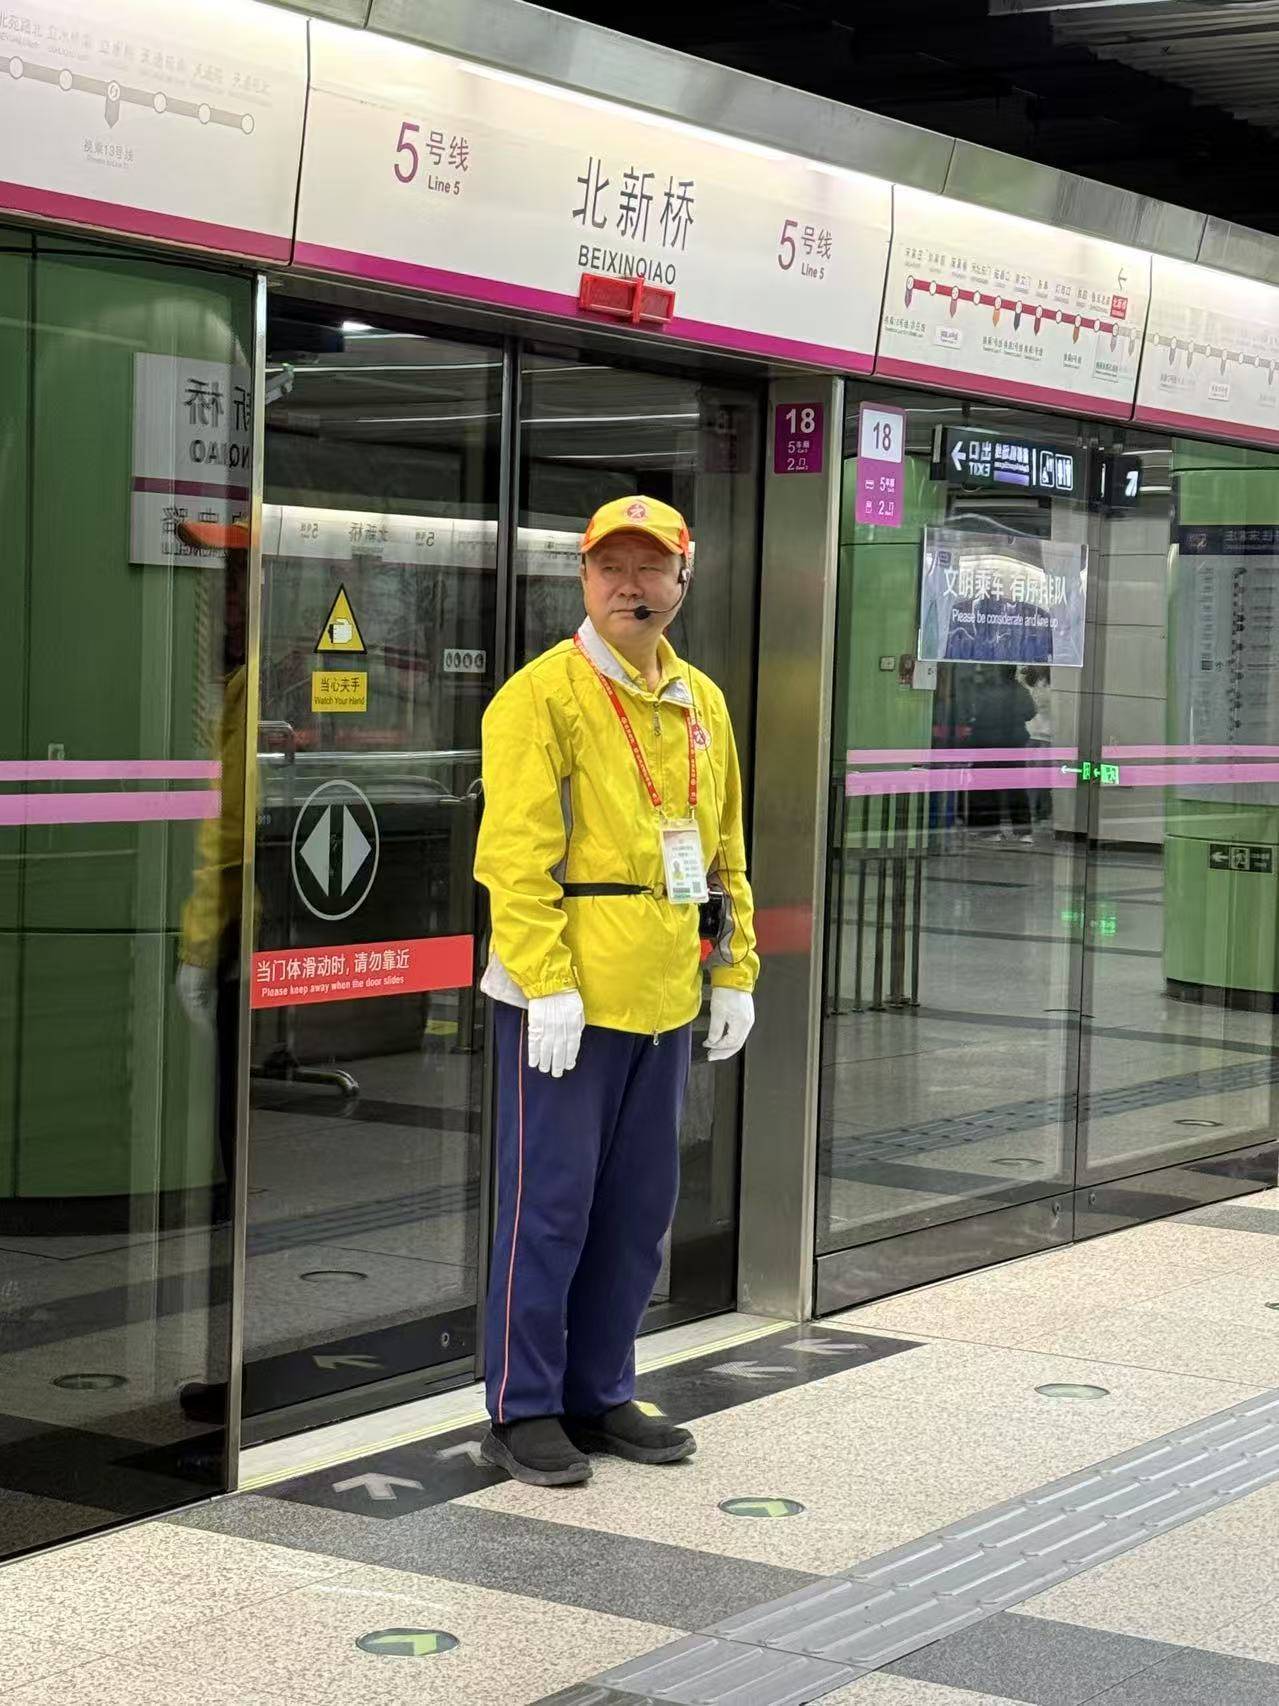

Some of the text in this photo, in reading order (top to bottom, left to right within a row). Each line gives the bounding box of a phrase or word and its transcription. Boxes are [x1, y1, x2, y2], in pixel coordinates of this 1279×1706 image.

[394, 122, 469, 183] 5号线
[428, 175, 461, 195] Line 5
[572, 156, 694, 251] 北新桥
[578, 245, 676, 285] BEIXINQIAO
[801, 262, 825, 280] Line 5
[786, 408, 815, 434] 18
[873, 421, 891, 451] 18
[943, 566, 1067, 605] 文明乘车 有序排队
[952, 608, 975, 623] Please
[977, 610, 987, 623] be
[987, 612, 1023, 625] considerate
[1025, 615, 1036, 626] and
[320, 677, 360, 692] 当心夹手
[262, 974, 405, 997] Please keep away when the door slides
